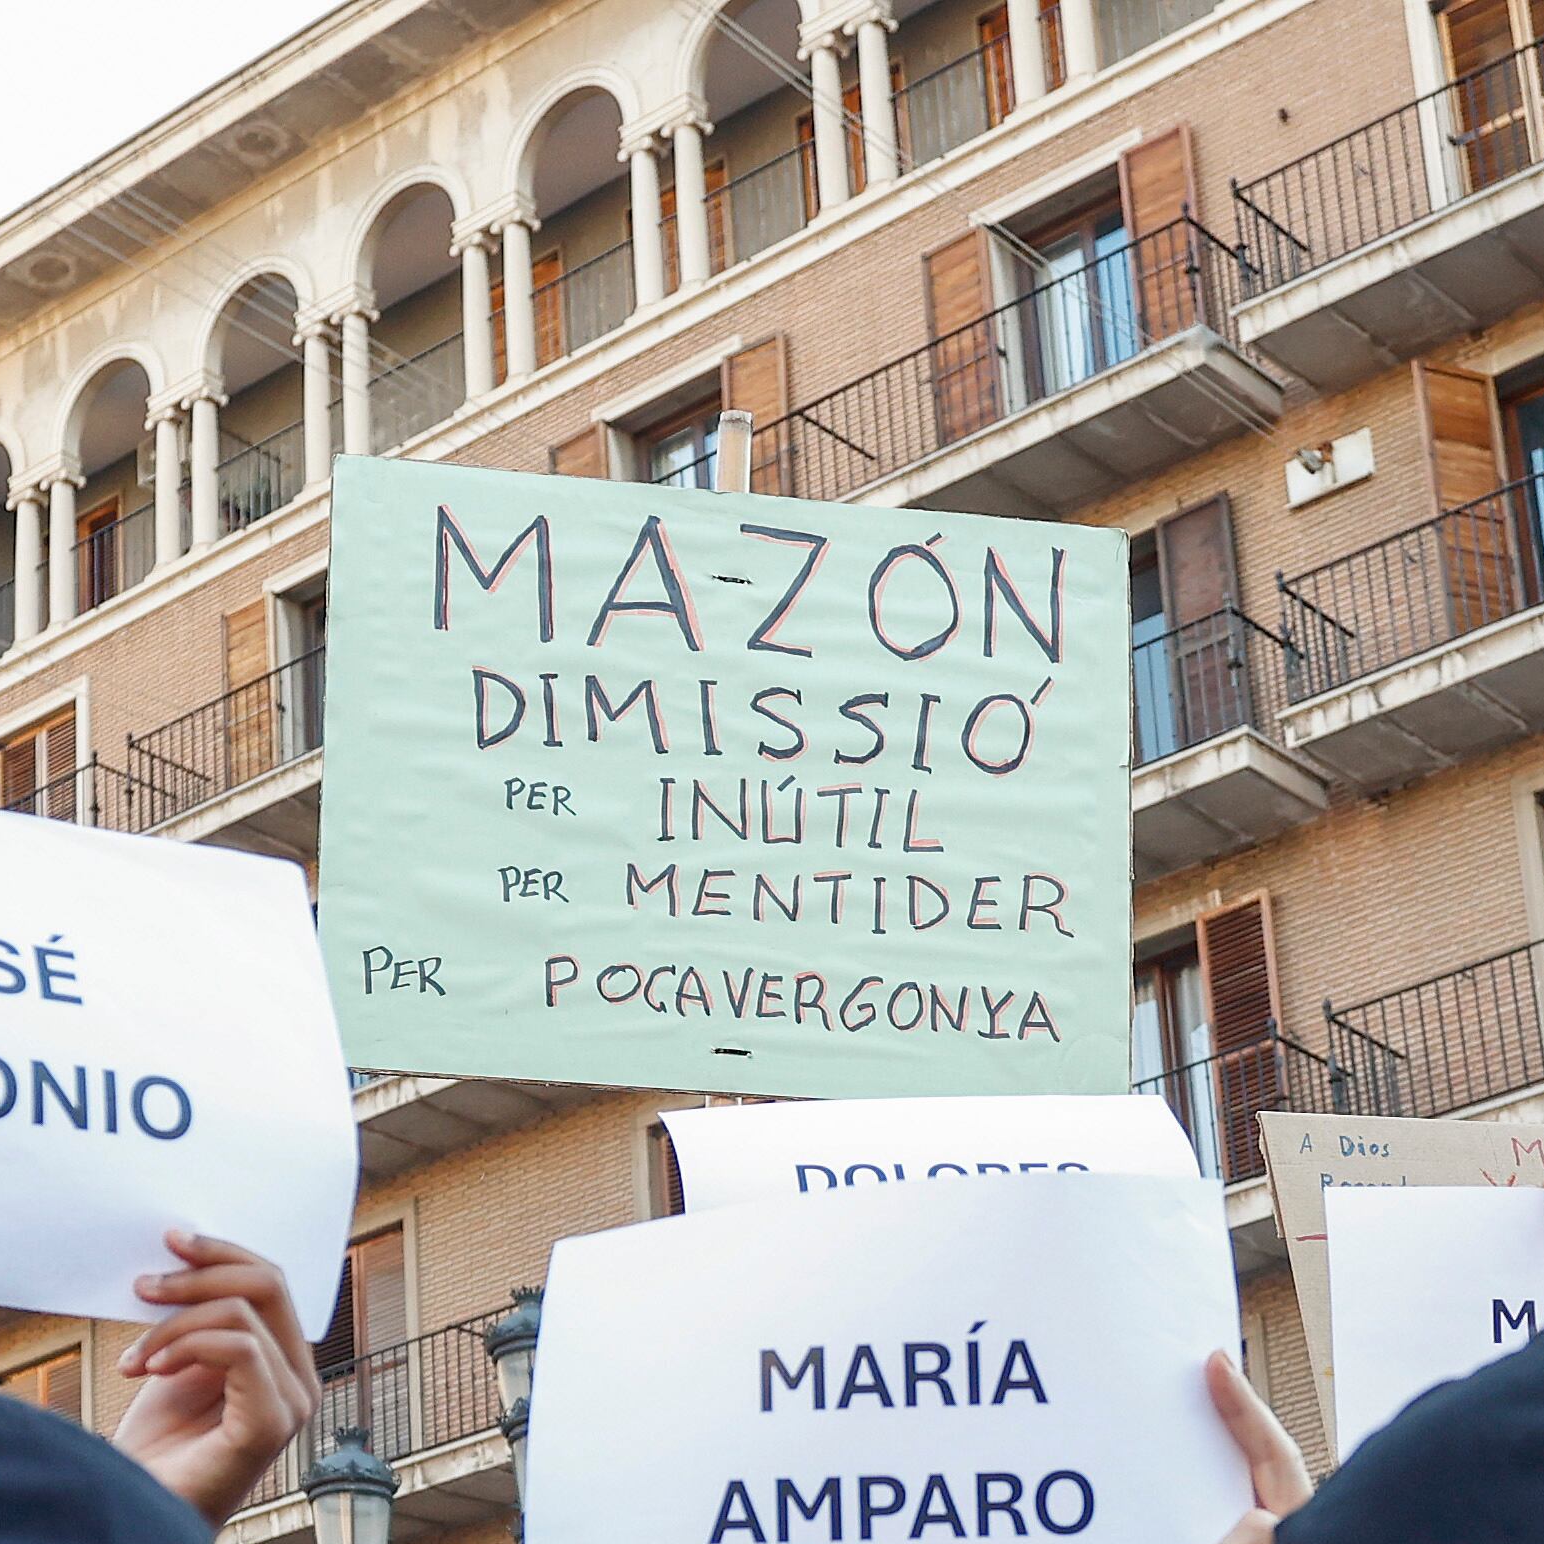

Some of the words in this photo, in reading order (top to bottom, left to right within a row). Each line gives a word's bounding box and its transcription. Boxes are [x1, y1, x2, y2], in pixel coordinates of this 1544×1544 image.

[433, 504, 1069, 665] MAZÓN
[472, 664, 1055, 776] DIMISSIÓ
[504, 777, 577, 816] PER
[656, 775, 945, 853] INÚTIL
[498, 866, 570, 904] PER
[624, 862, 1075, 938] MENTIDER
[362, 945, 447, 998] PER
[544, 954, 1063, 1044] POCAVERGONYA
[1299, 1132, 1313, 1154] A
[1338, 1134, 1391, 1158] Dios
[759, 1320, 1050, 1413] MARÍA
